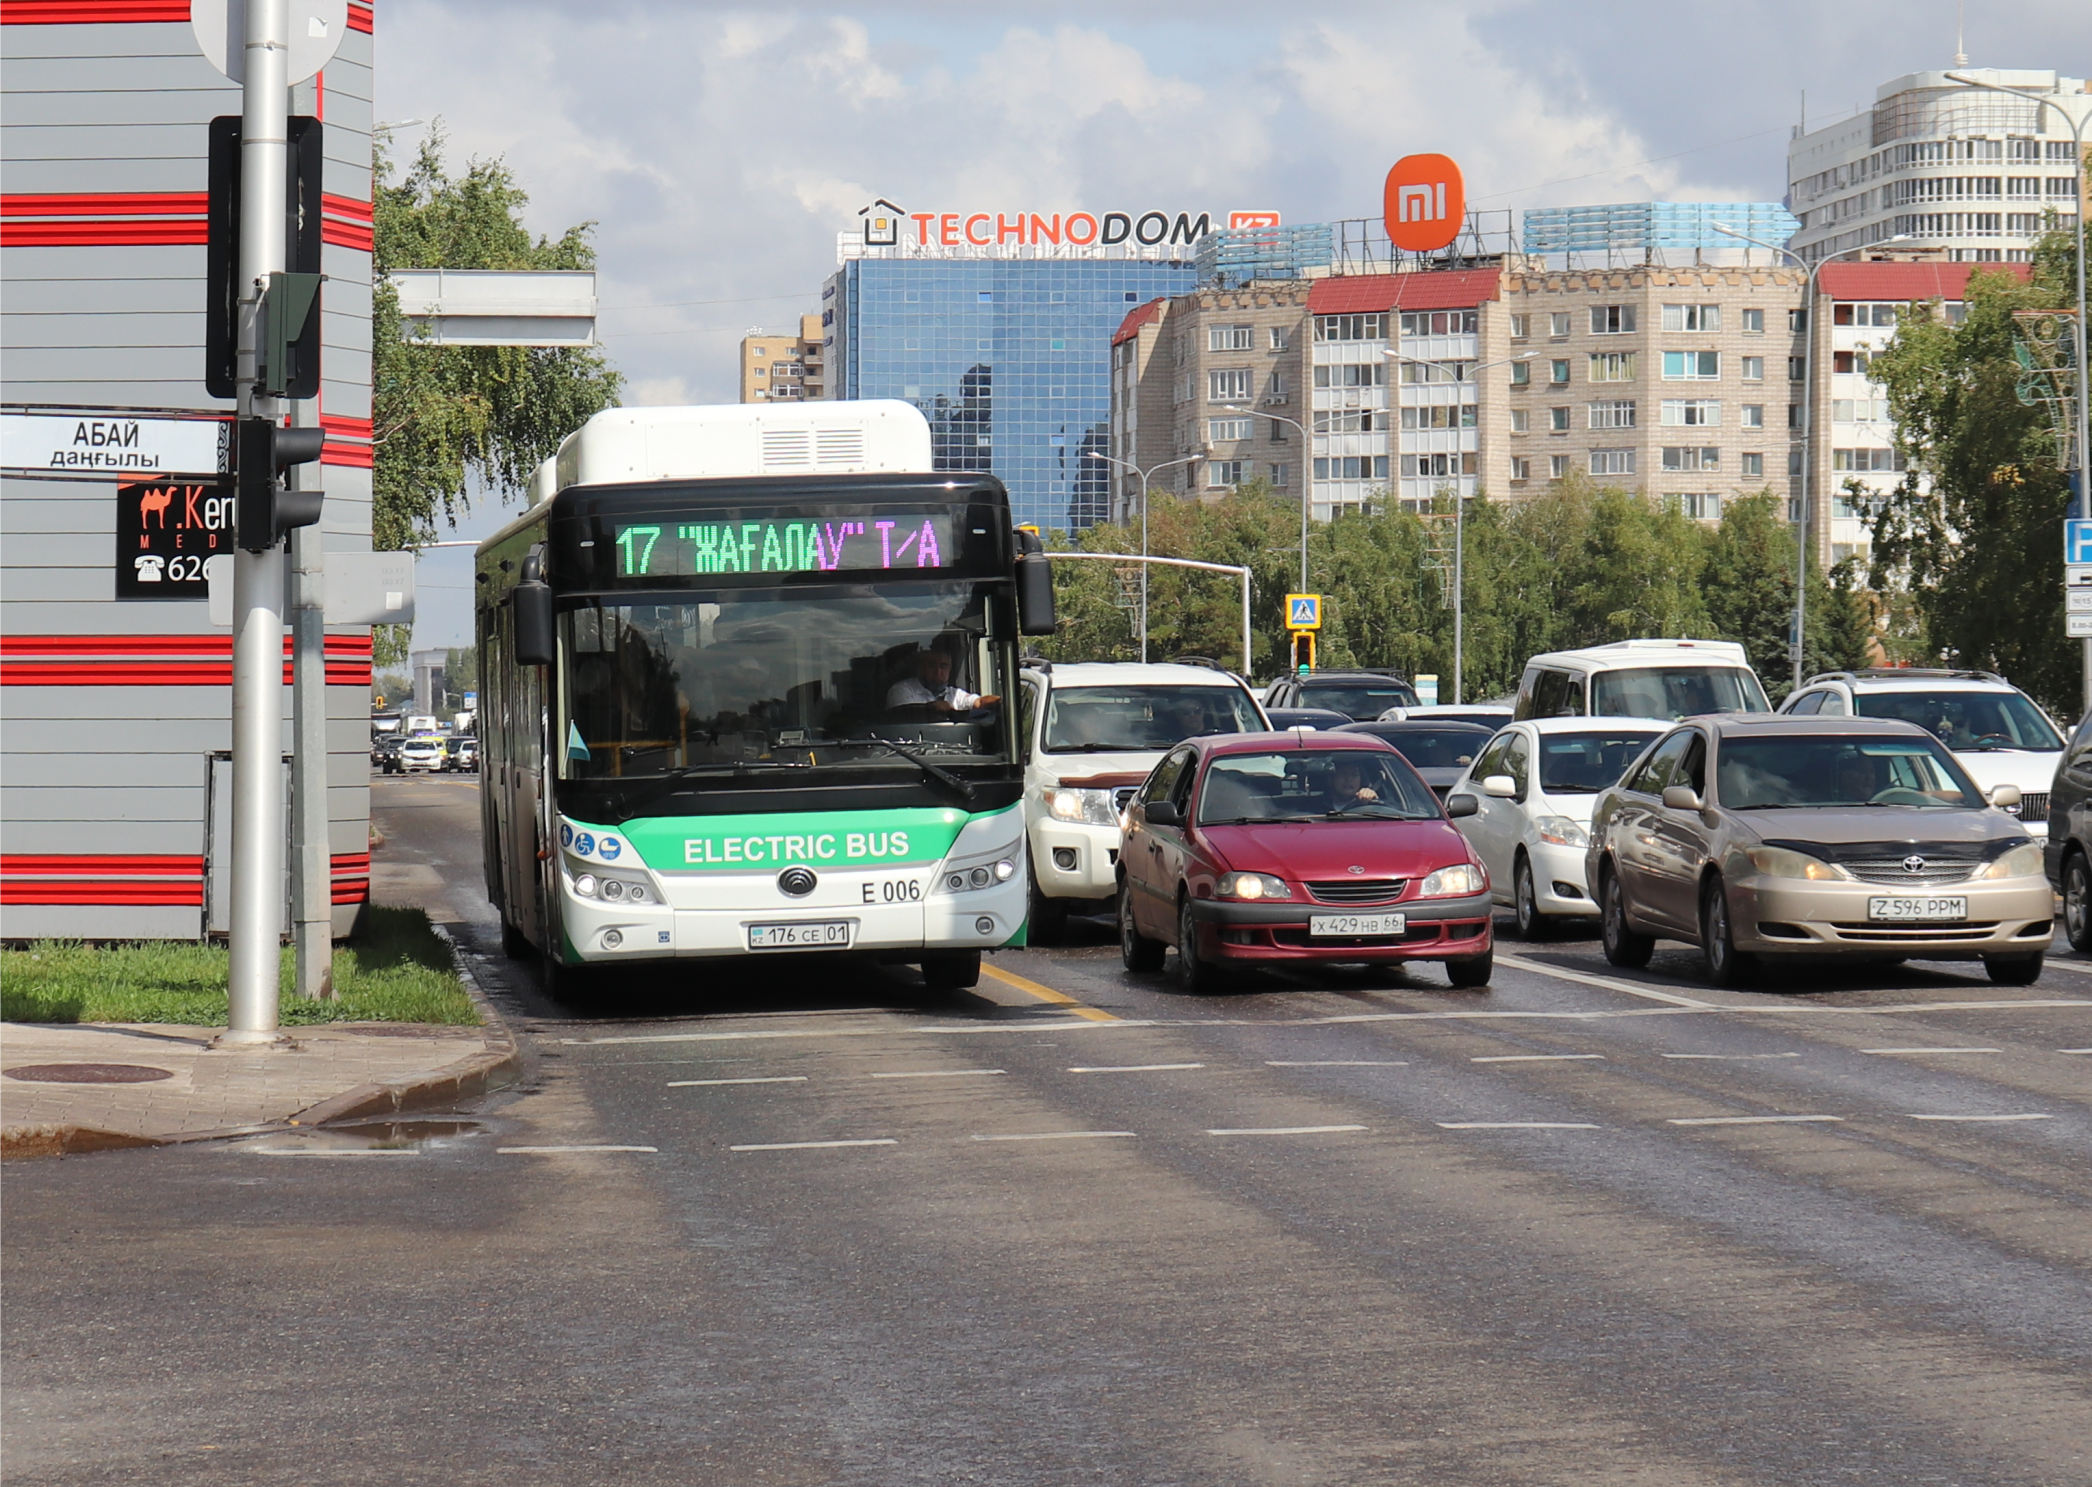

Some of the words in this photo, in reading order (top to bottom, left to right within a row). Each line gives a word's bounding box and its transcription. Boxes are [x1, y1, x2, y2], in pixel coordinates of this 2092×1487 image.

[909, 211, 1210, 246] TECHNODOM
[73, 420, 139, 448] АБАЙ
[50, 451, 159, 468] даңғылы
[176, 485, 236, 530] .Ker
[616, 526, 661, 575] 17
[684, 834, 837, 863] ELECTRIC
[846, 831, 910, 858] BUS
[862, 882, 876, 903] E
[883, 879, 920, 902] 006
[1876, 900, 1888, 915] Z
[1893, 900, 1922, 915] 596
[1927, 899, 1961, 915] PPM
[768, 927, 796, 943] 176
[827, 925, 845, 941] 01
[1329, 917, 1358, 933] 429
[1384, 916, 1399, 928] 66
